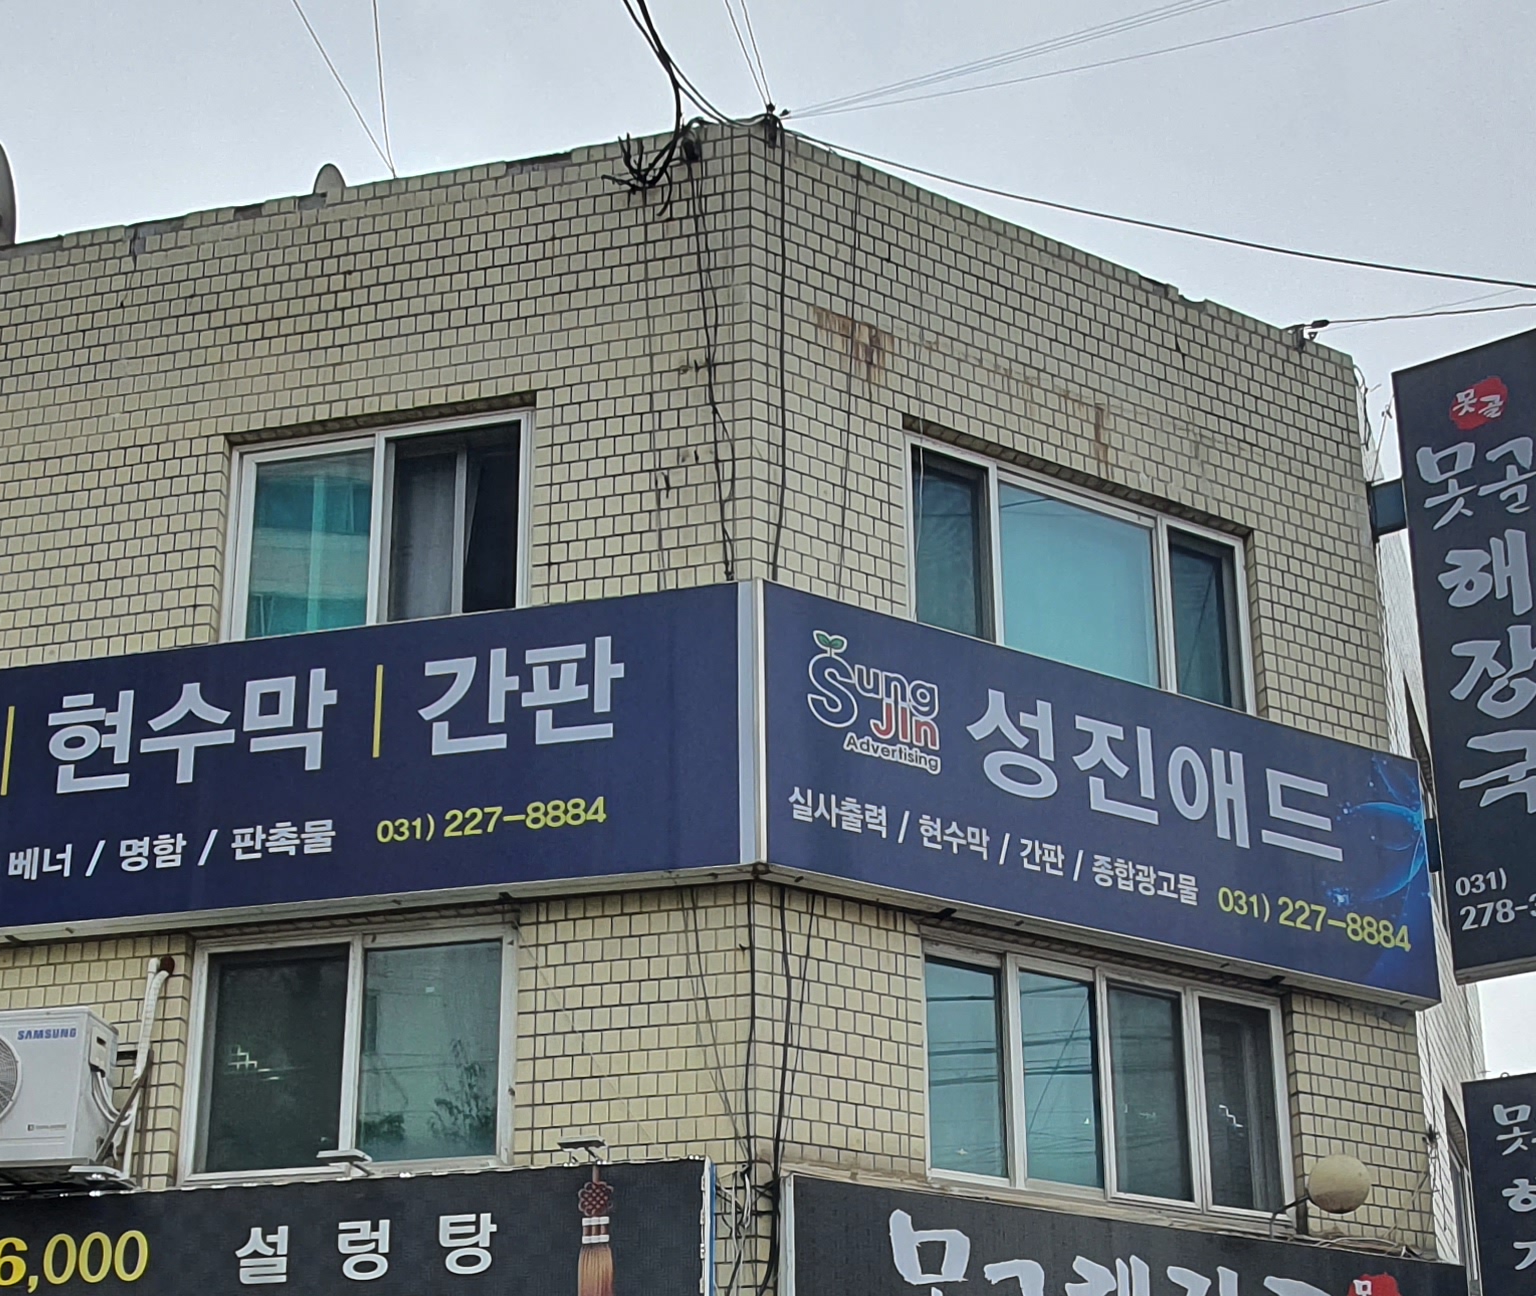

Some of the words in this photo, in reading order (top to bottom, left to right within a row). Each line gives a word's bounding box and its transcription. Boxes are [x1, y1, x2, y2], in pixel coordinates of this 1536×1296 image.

[48, 667, 338, 794] 현수막
[418, 636, 624, 756] 간판
[808, 652, 939, 728] Sung
[844, 731, 940, 775] Advertising
[966, 687, 1343, 862] 성진애드
[8, 845, 71, 882] 베너
[119, 832, 186, 873] 명함
[231, 819, 335, 861] 판촉물
[377, 814, 434, 844] 031)
[443, 795, 606, 839] 227-8884
[788, 785, 888, 841] 실사출력
[919, 814, 990, 861] 현수막
[1019, 837, 1065, 878] 간판
[1092, 853, 1199, 906] 종합광고물
[1218, 886, 1270, 925] 031)
[1278, 897, 1412, 953] 227-8884
[1454, 868, 1507, 897] 031)
[17, 1028, 77, 1040] SAMSUNG
